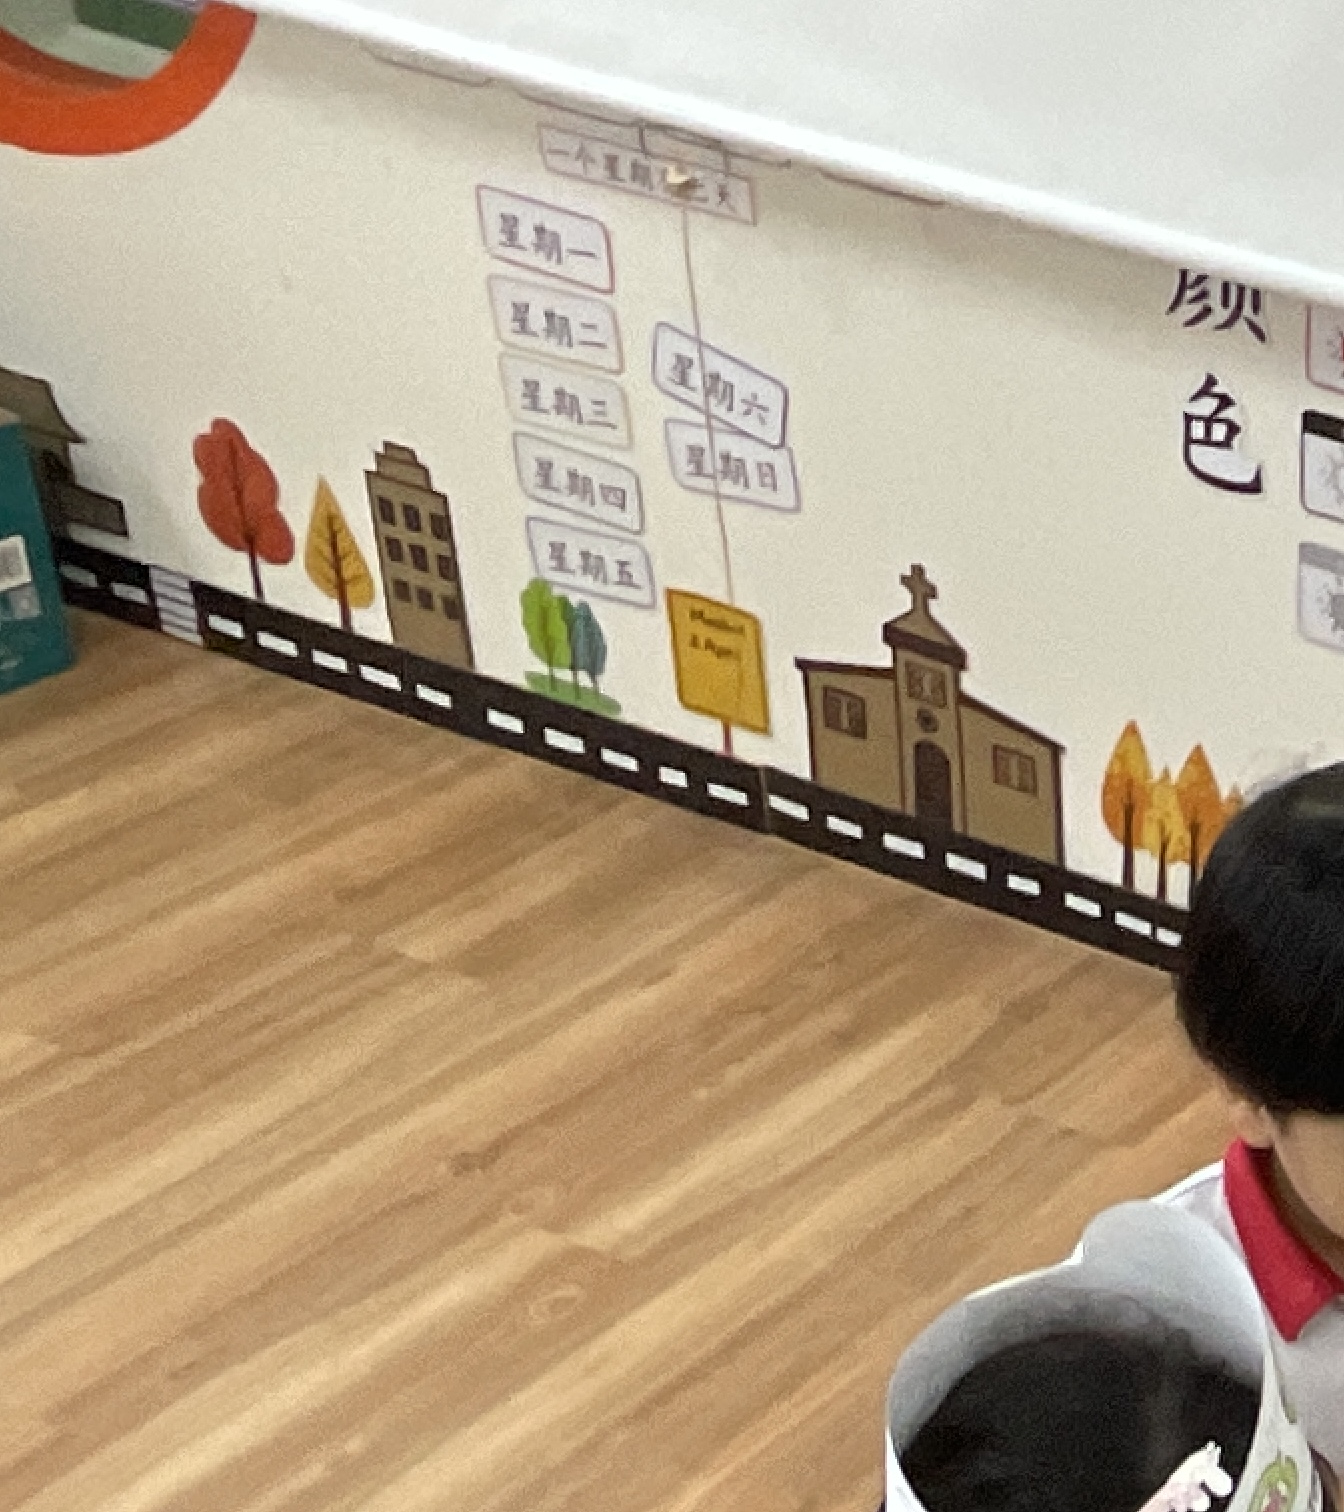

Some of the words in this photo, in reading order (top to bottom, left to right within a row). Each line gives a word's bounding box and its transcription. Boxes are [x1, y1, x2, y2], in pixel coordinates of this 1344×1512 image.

[499, 212, 598, 266] 星期一
[511, 302, 607, 350] 星期二
[521, 378, 618, 430] 星期三
[671, 353, 770, 426] 星期六
[534, 456, 627, 512] 星期四
[685, 443, 779, 492] 星期日
[548, 541, 641, 590] 星期五
